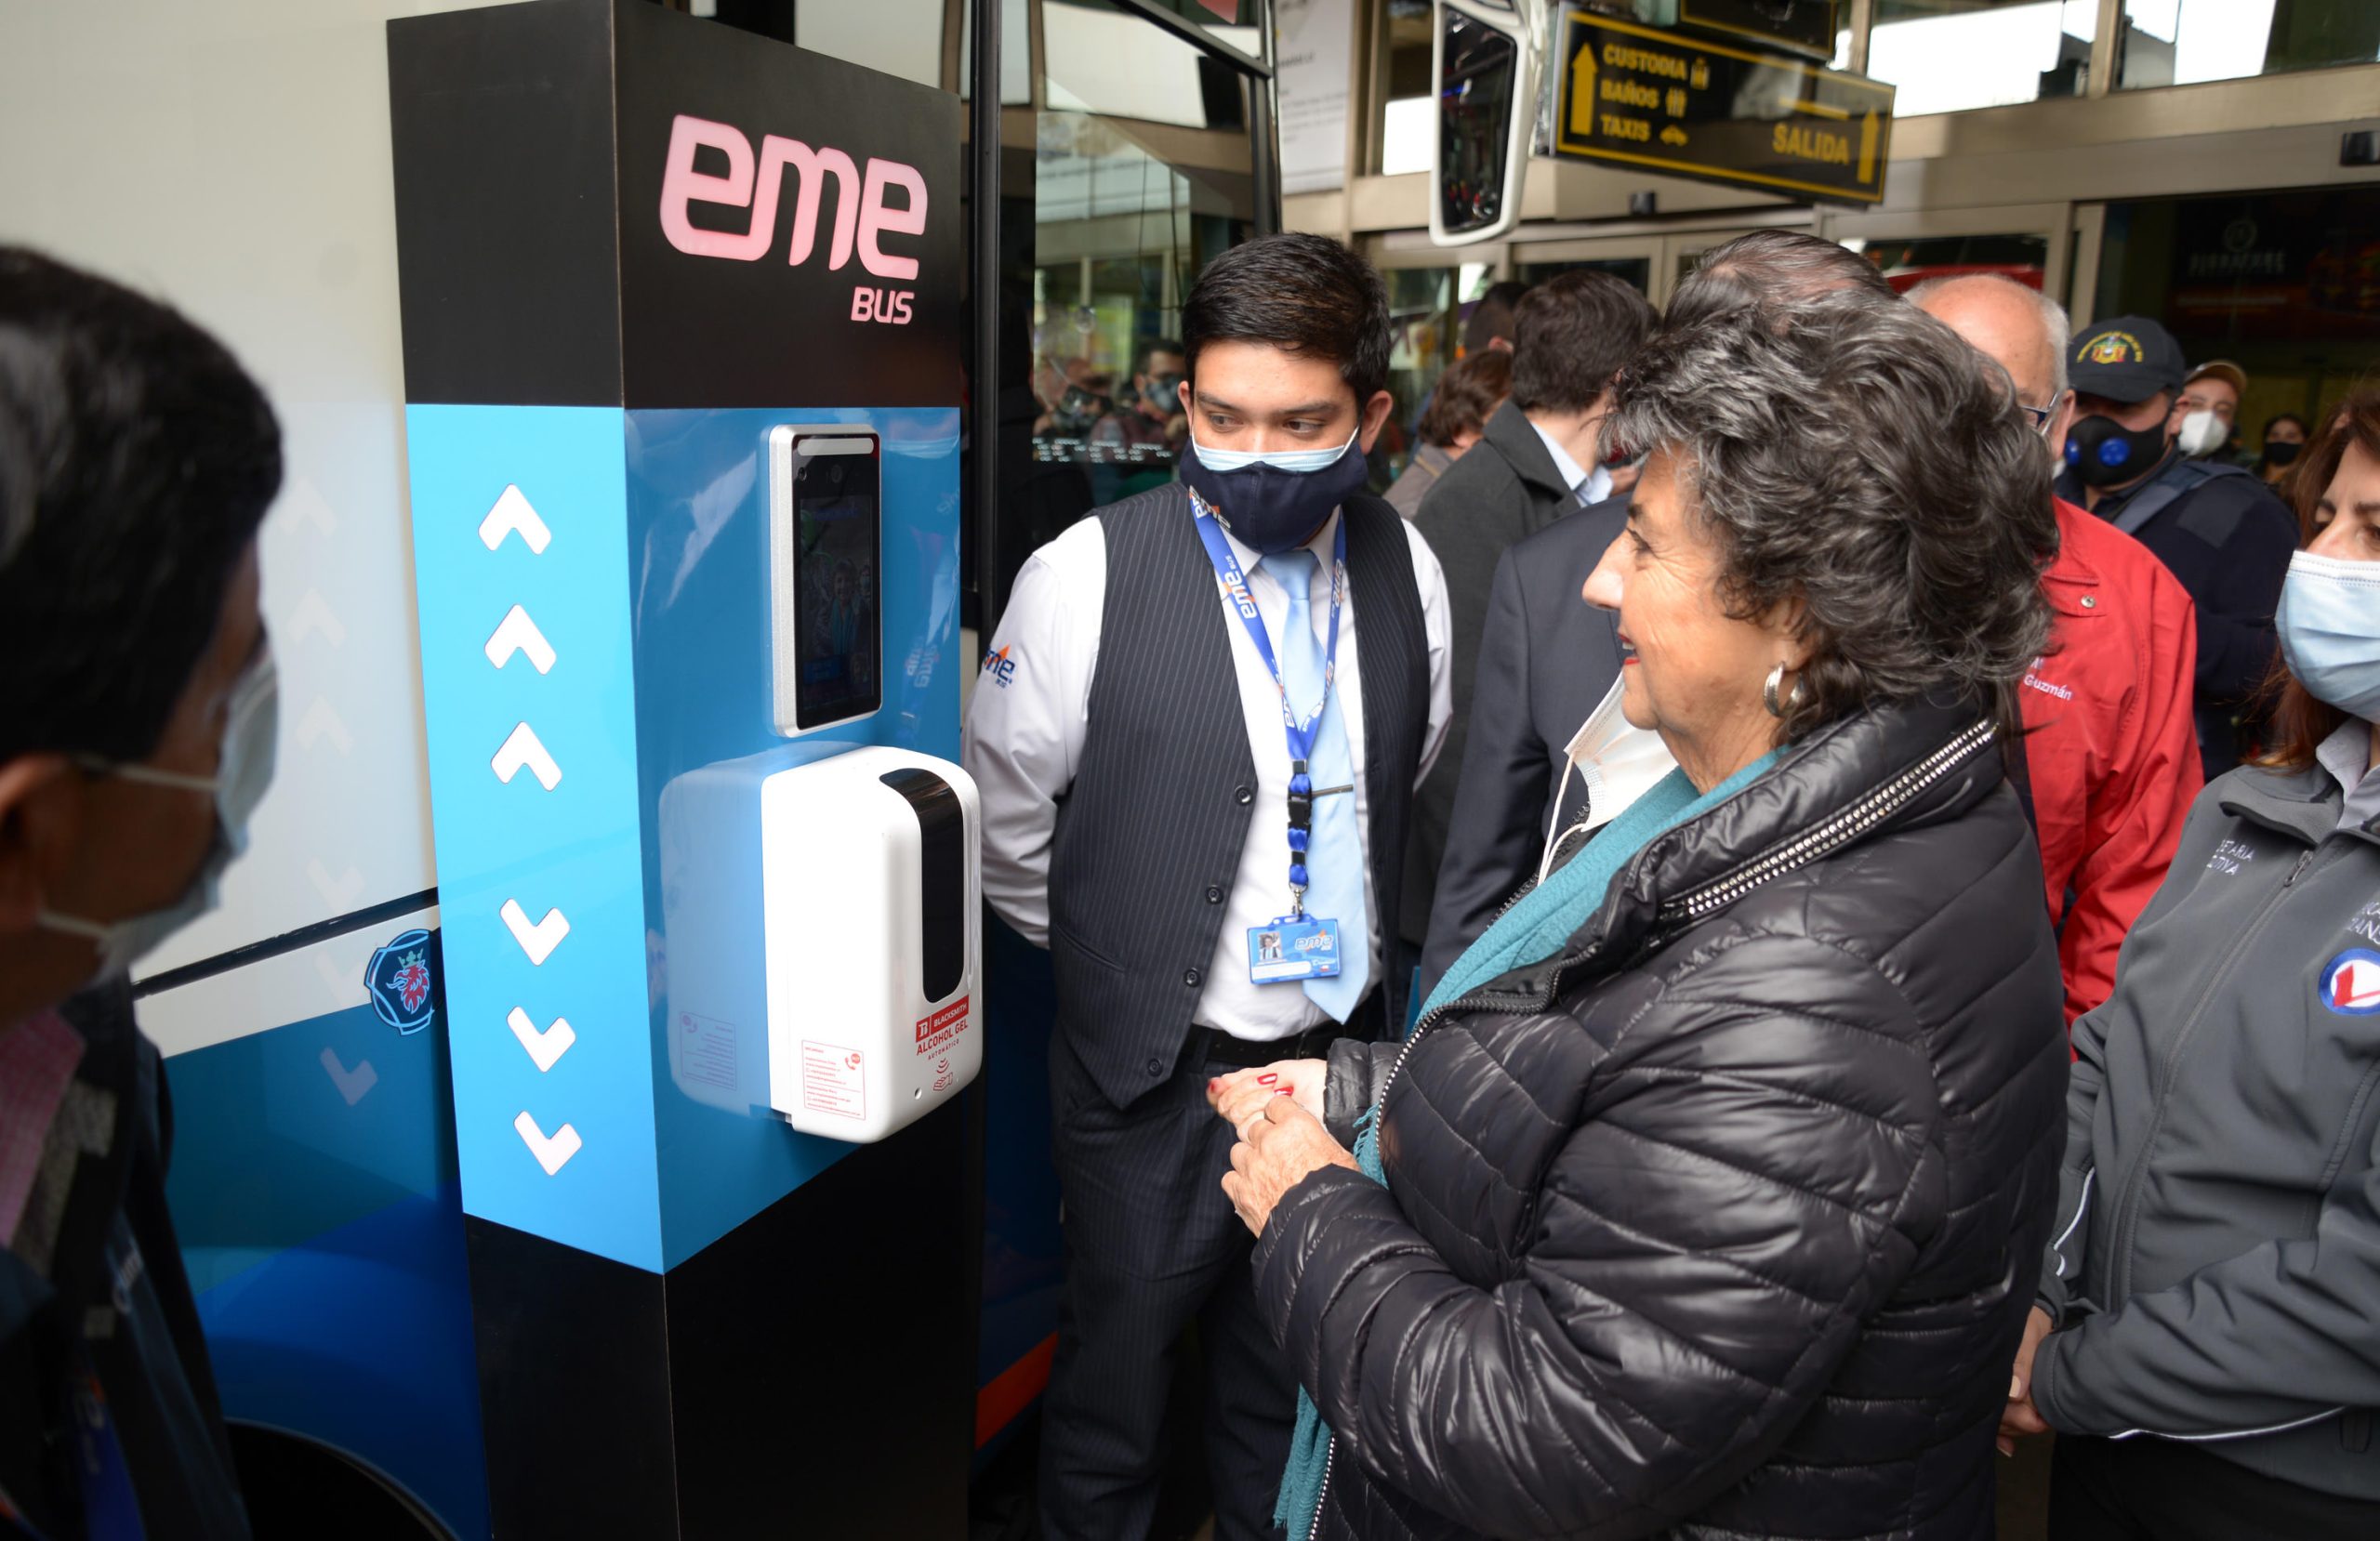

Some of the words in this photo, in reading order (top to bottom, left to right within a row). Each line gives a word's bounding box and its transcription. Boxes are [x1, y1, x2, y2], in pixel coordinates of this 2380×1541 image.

[1603, 43, 1687, 80] CUSTODIA
[1599, 78, 1660, 110] BAÑOS
[1599, 113, 1652, 143] TAXIS
[1772, 122, 1850, 165] SALIDA
[659, 113, 929, 282] eme
[850, 285, 916, 325] BUS
[2023, 673, 2073, 702] Guzmán
[933, 1002, 968, 1028] BLACKSMITH
[916, 1027, 954, 1057] ALCOHOL
[955, 1018, 969, 1034] GEL
